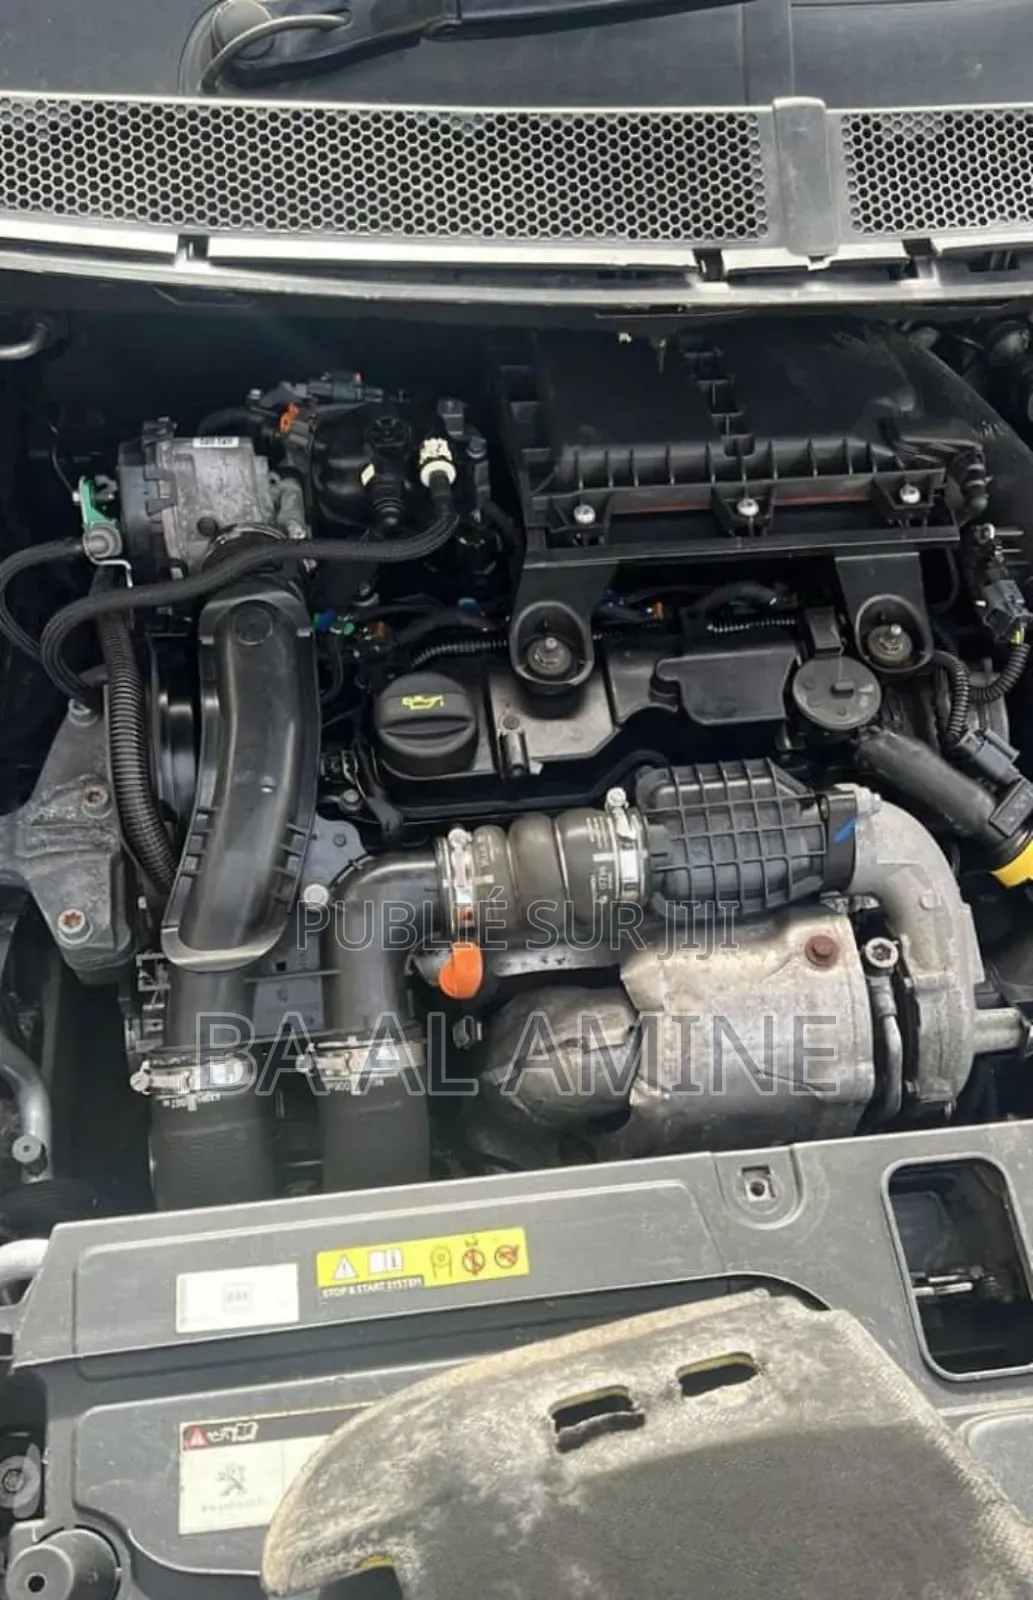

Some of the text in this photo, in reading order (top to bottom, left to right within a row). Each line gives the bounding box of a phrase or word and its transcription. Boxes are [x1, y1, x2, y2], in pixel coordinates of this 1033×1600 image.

[322, 1287, 347, 1298] STOP
[357, 1282, 385, 1293] START
[387, 1278, 421, 1290] SYSTEM
